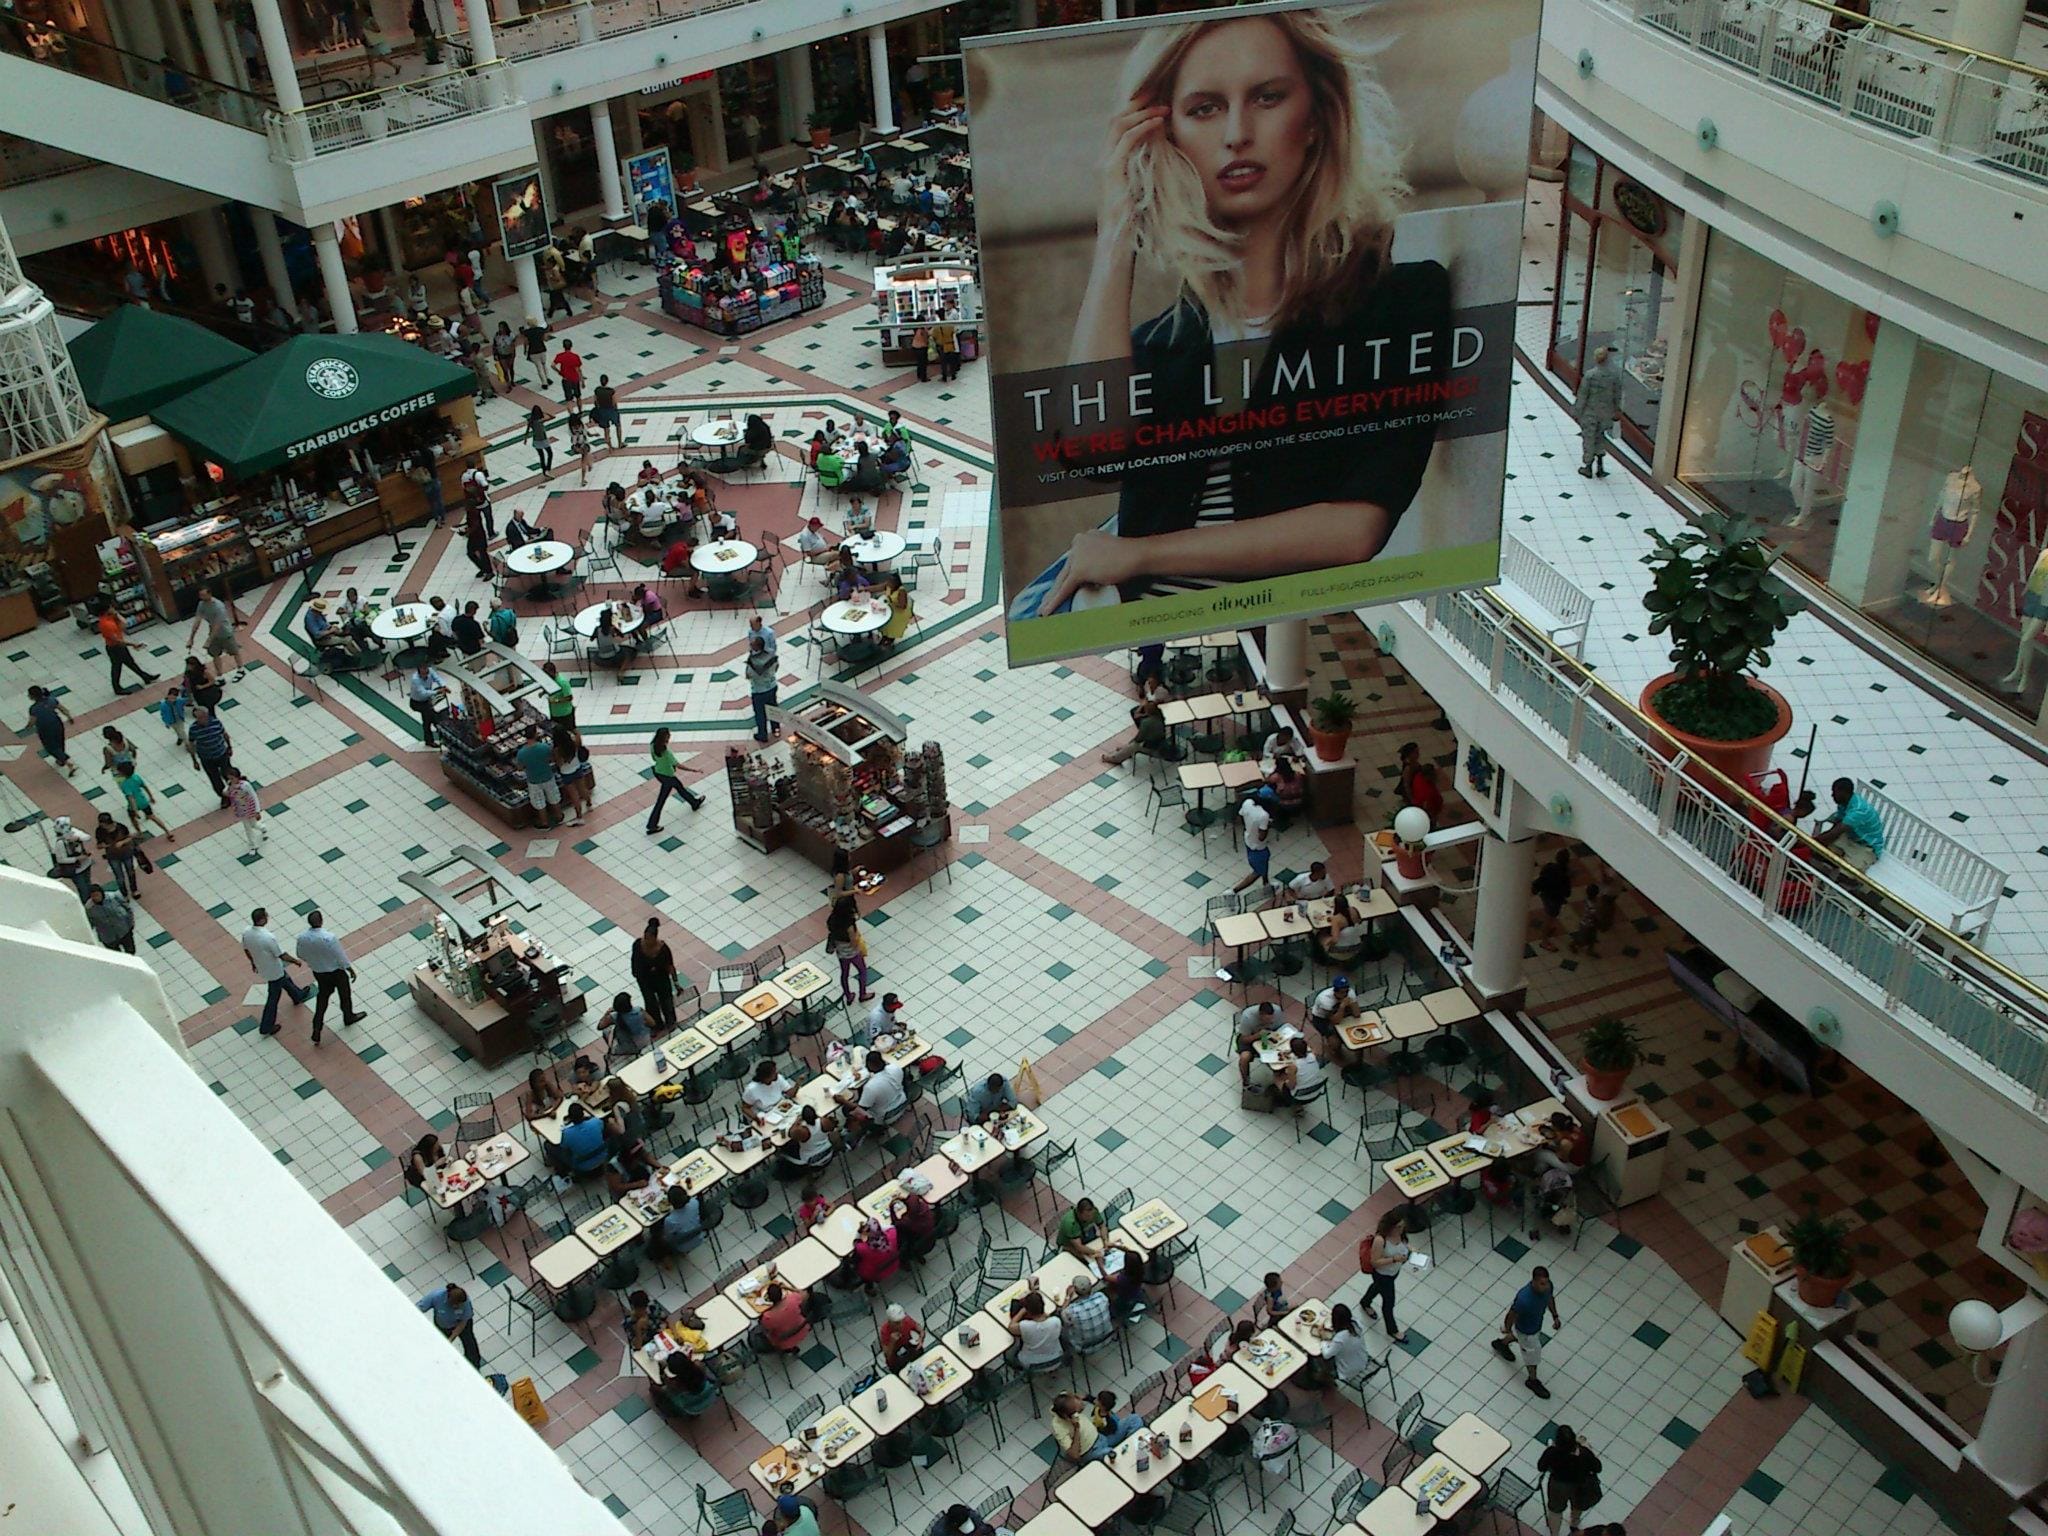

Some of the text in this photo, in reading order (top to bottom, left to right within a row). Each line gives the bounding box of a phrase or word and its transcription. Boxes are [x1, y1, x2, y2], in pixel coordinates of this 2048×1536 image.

[309, 359, 350, 384] STARBUCKS
[323, 382, 356, 397] COFFEE
[1023, 326, 1484, 432] THE LIMITED
[286, 392, 436, 459] STARBUCKS COFFEE
[1032, 375, 1480, 463] WE'RE CHANGING EVERYTHING!
[1038, 470, 1067, 484] VISIT
[1069, 467, 1095, 478] OUR
[1097, 462, 1125, 474] NEW
[1128, 452, 1187, 469] LOCATION
[1189, 447, 1218, 460] NOW
[1220, 440, 1252, 454] OPEN
[1254, 440, 1273, 451] ON
[1275, 434, 1296, 446] THE
[1298, 427, 1345, 442] SECOND
[1347, 422, 1381, 436] LEVEL
[1384, 417, 1413, 430] NEXT
[1416, 413, 1430, 424] TO
[1129, 570, 1424, 628] INTRODUCING eloquii FULL-FIGURED FASHION
